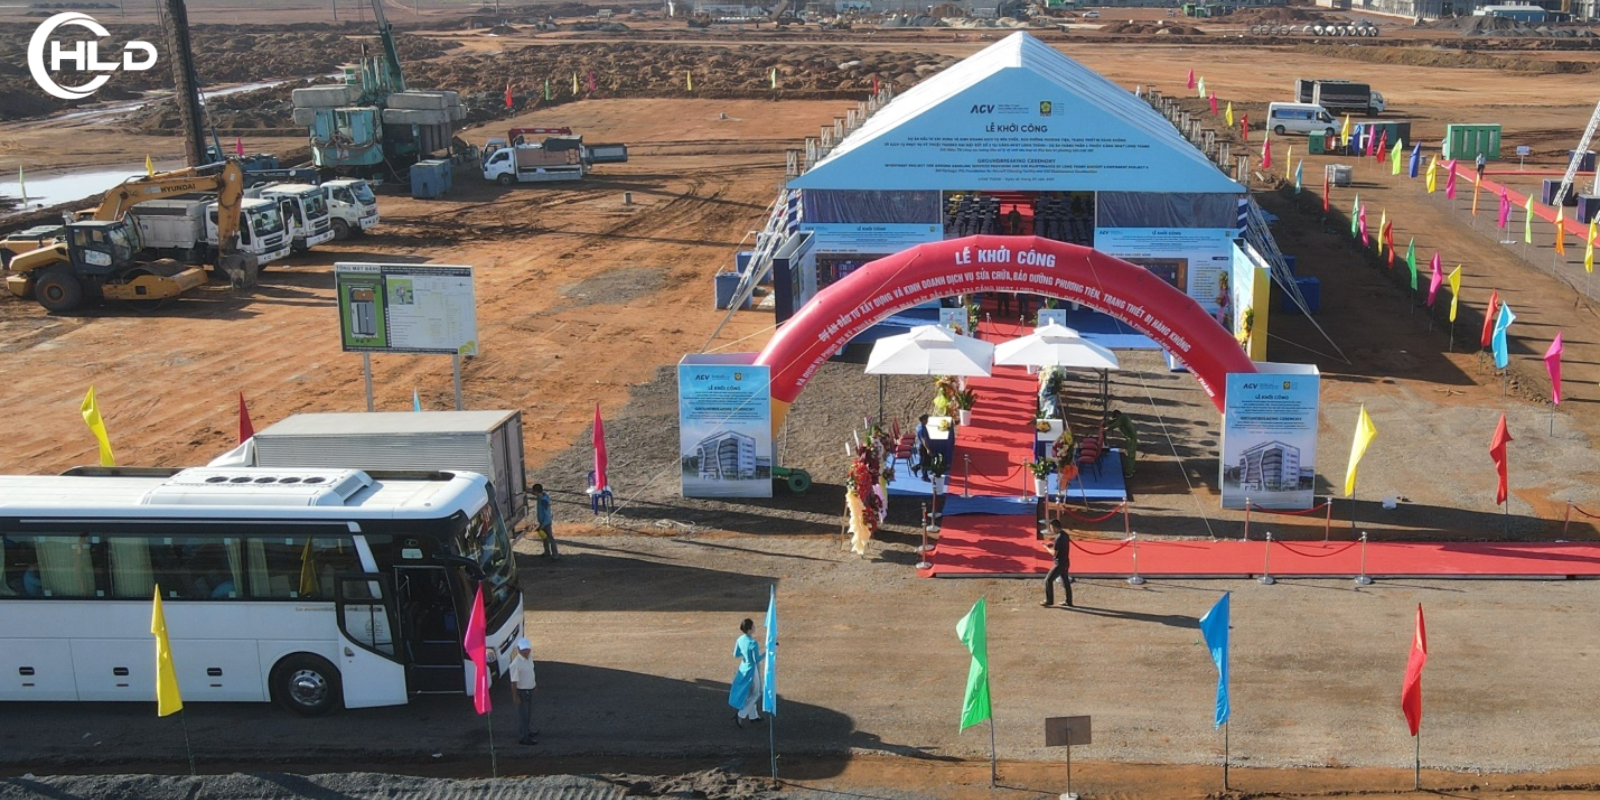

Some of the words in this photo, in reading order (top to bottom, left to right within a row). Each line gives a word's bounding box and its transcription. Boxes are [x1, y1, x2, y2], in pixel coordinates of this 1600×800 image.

[970, 104, 995, 114] ACV
[986, 122, 995, 132] LỄ
[998, 122, 1018, 132] KHỞI
[1021, 123, 1048, 133] CÔNG
[160, 184, 196, 193] HYUNDAI
[955, 246, 972, 265] LỄ
[978, 245, 1010, 263] KHỞI
[1018, 249, 1056, 267] CÔNG
